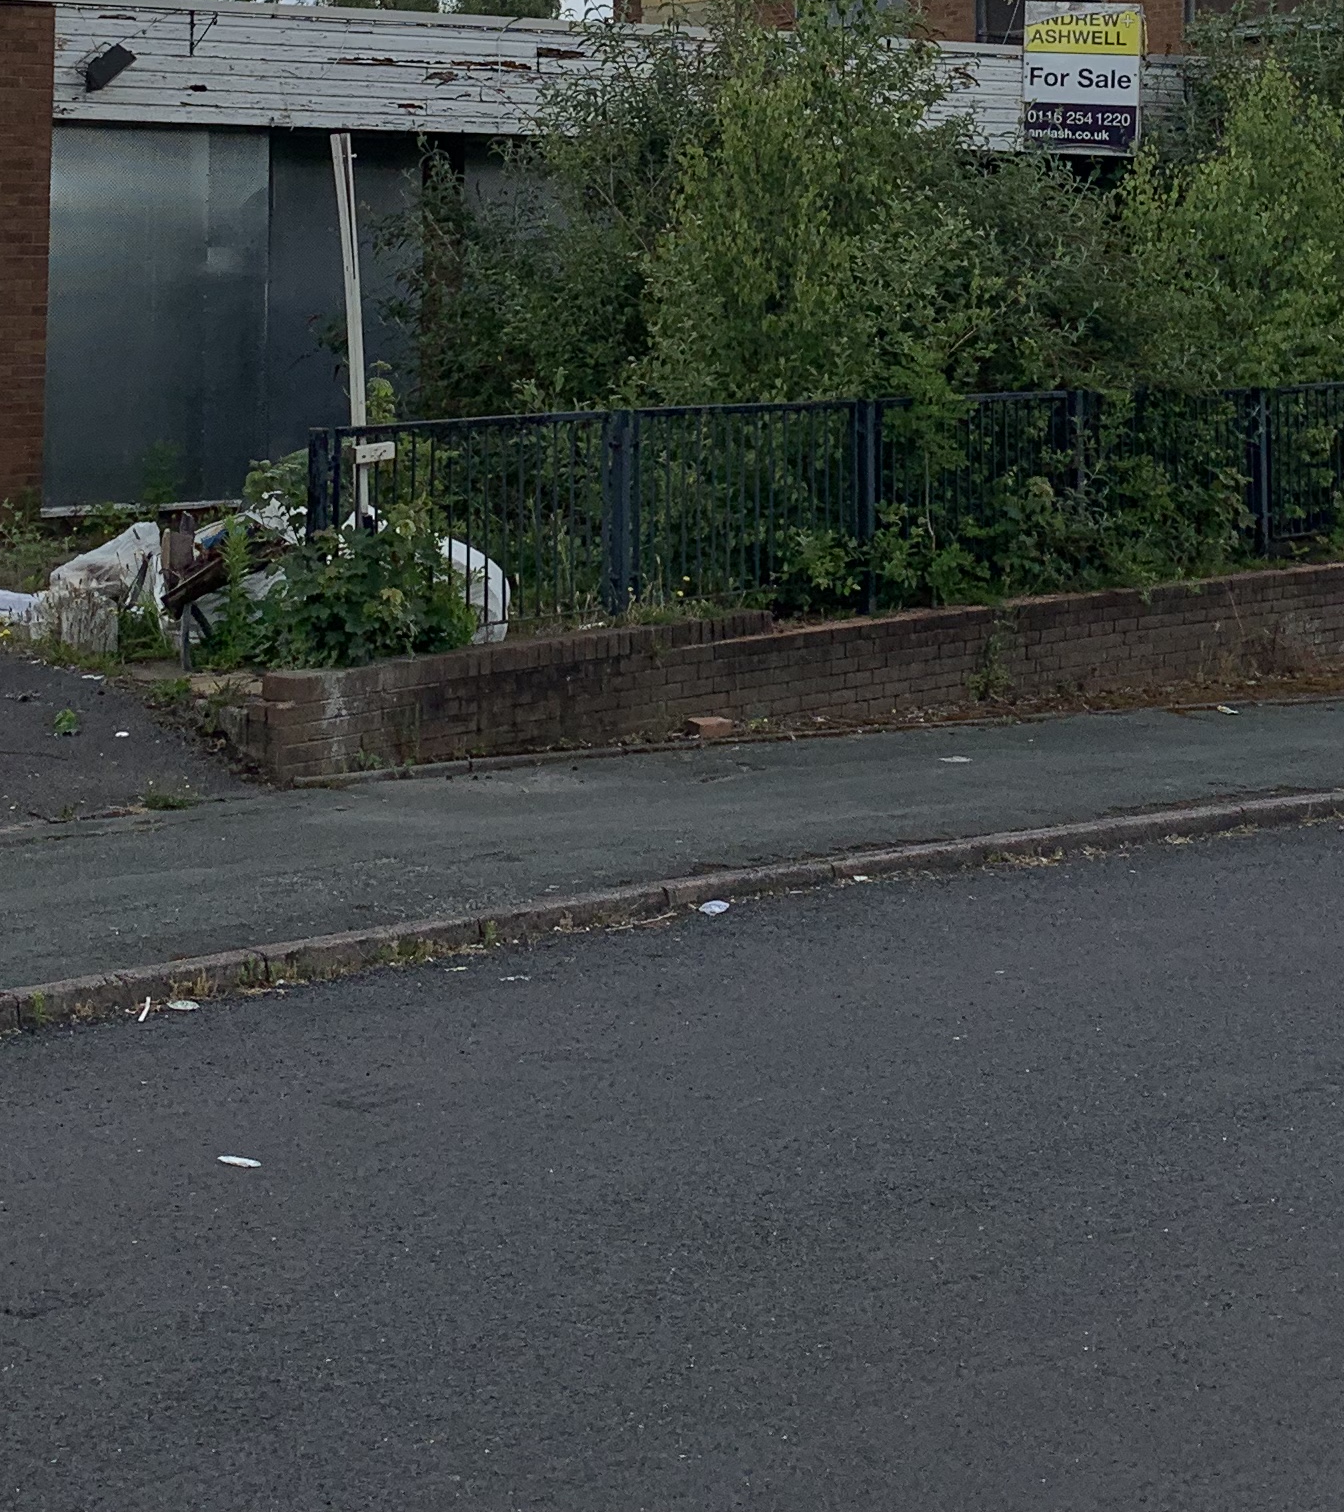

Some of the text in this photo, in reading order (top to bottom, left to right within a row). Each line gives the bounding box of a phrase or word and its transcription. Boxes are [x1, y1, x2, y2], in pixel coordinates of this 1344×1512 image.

[1031, 29, 1127, 46] ASHWELL
[1029, 66, 1132, 90] For Sale
[1066, 111, 1093, 125] 254
[1096, 112, 1131, 127] 1220
